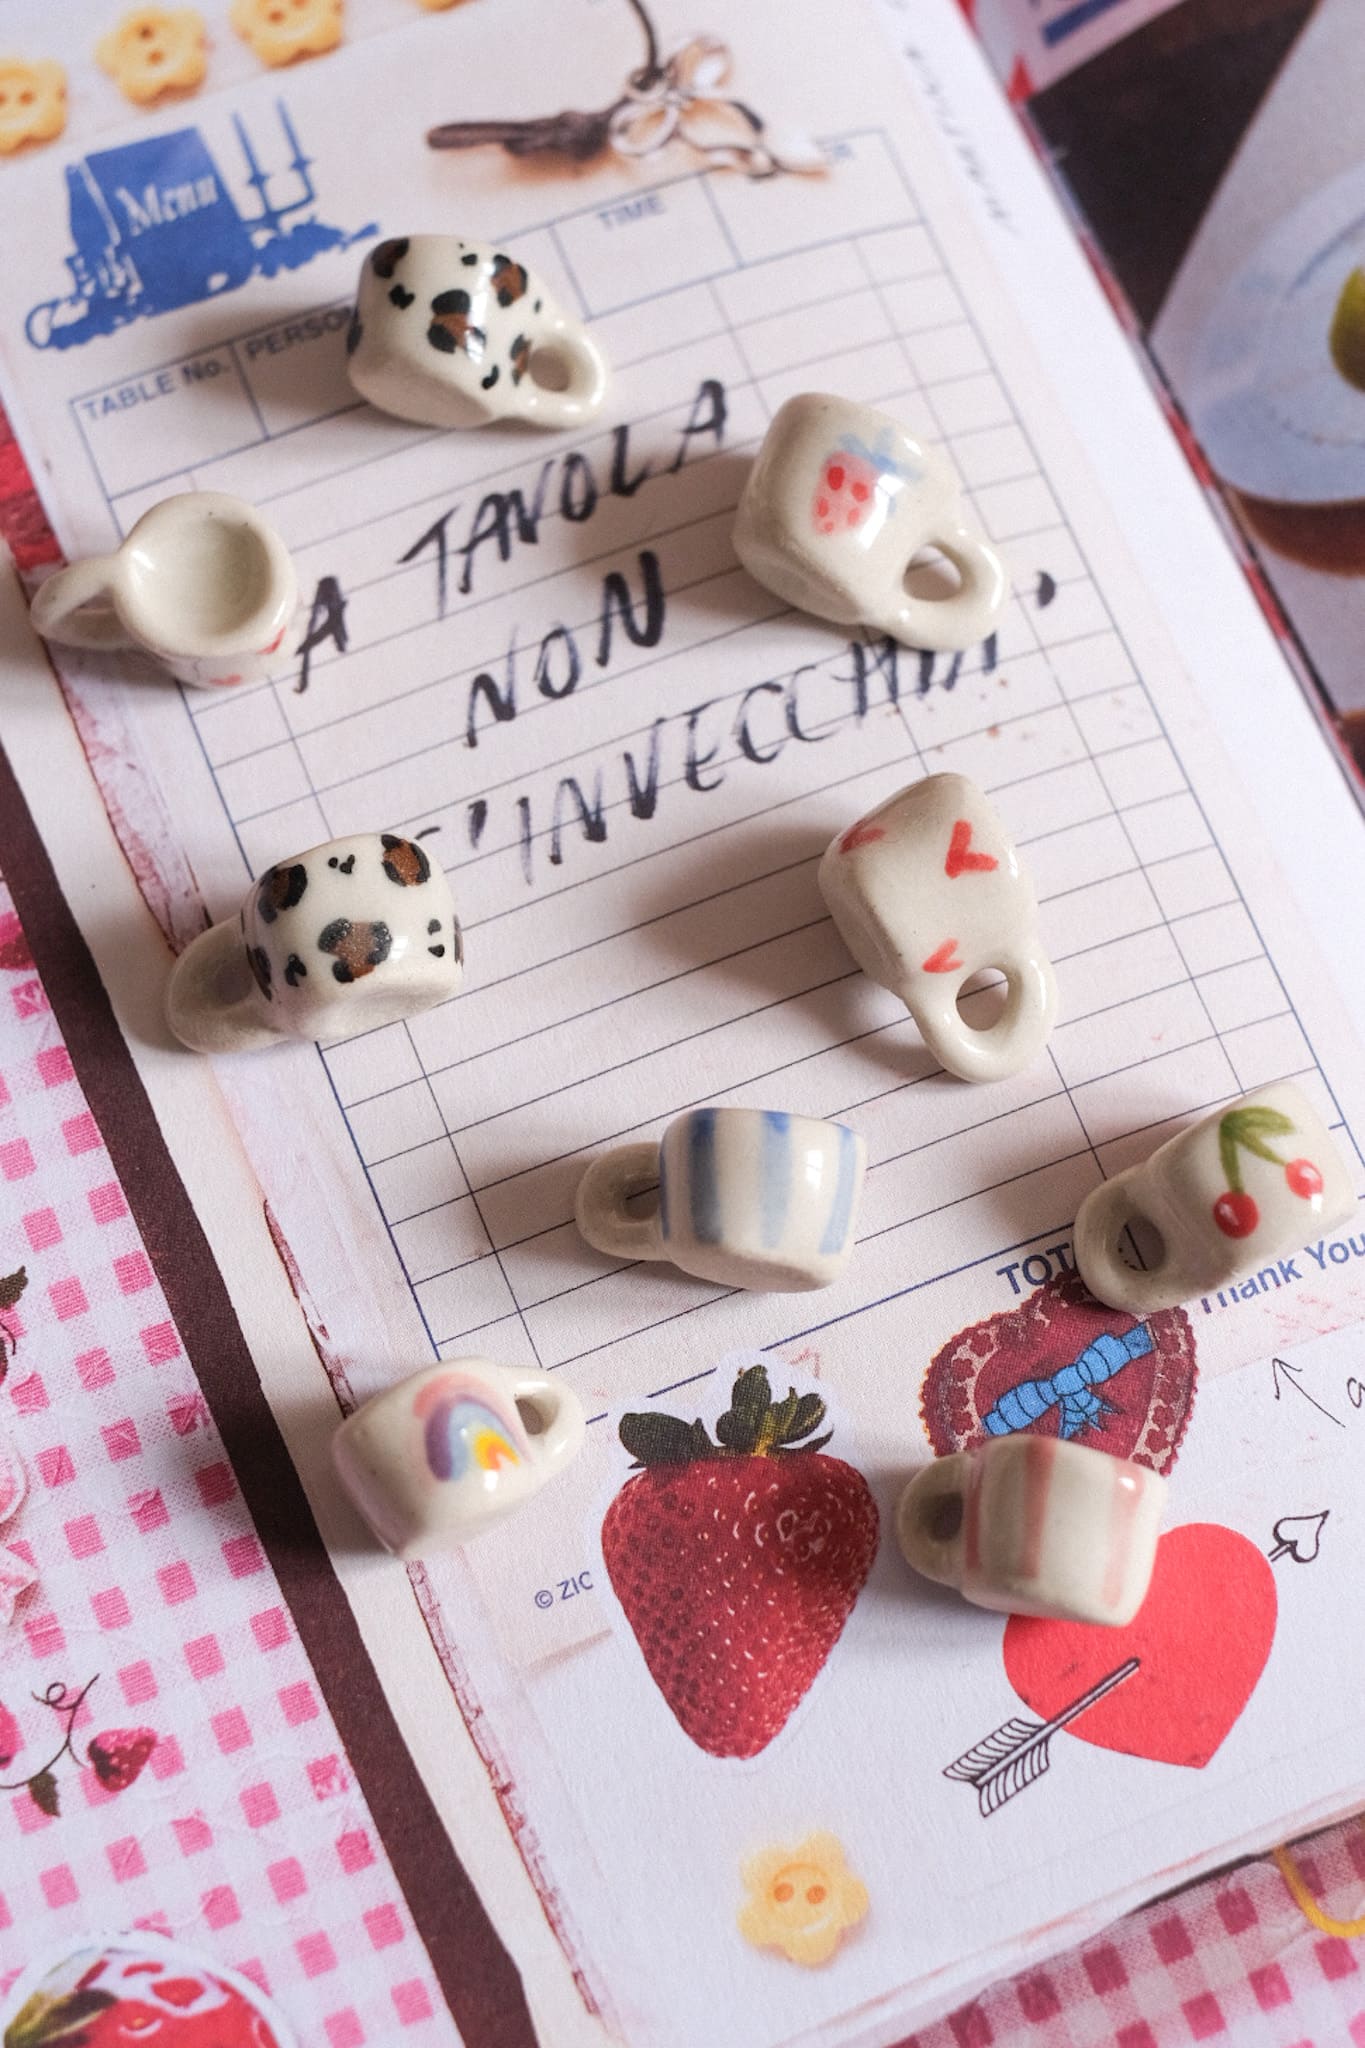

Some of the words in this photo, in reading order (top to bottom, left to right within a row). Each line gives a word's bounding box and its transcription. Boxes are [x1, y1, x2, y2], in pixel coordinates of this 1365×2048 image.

[115, 174, 218, 237] Menu
[82, 371, 177, 420] TABLE
[294, 576, 348, 692] A
[396, 379, 729, 620] TAVOLA
[463, 548, 665, 747] NON
[1304, 1232, 1365, 1270] You
